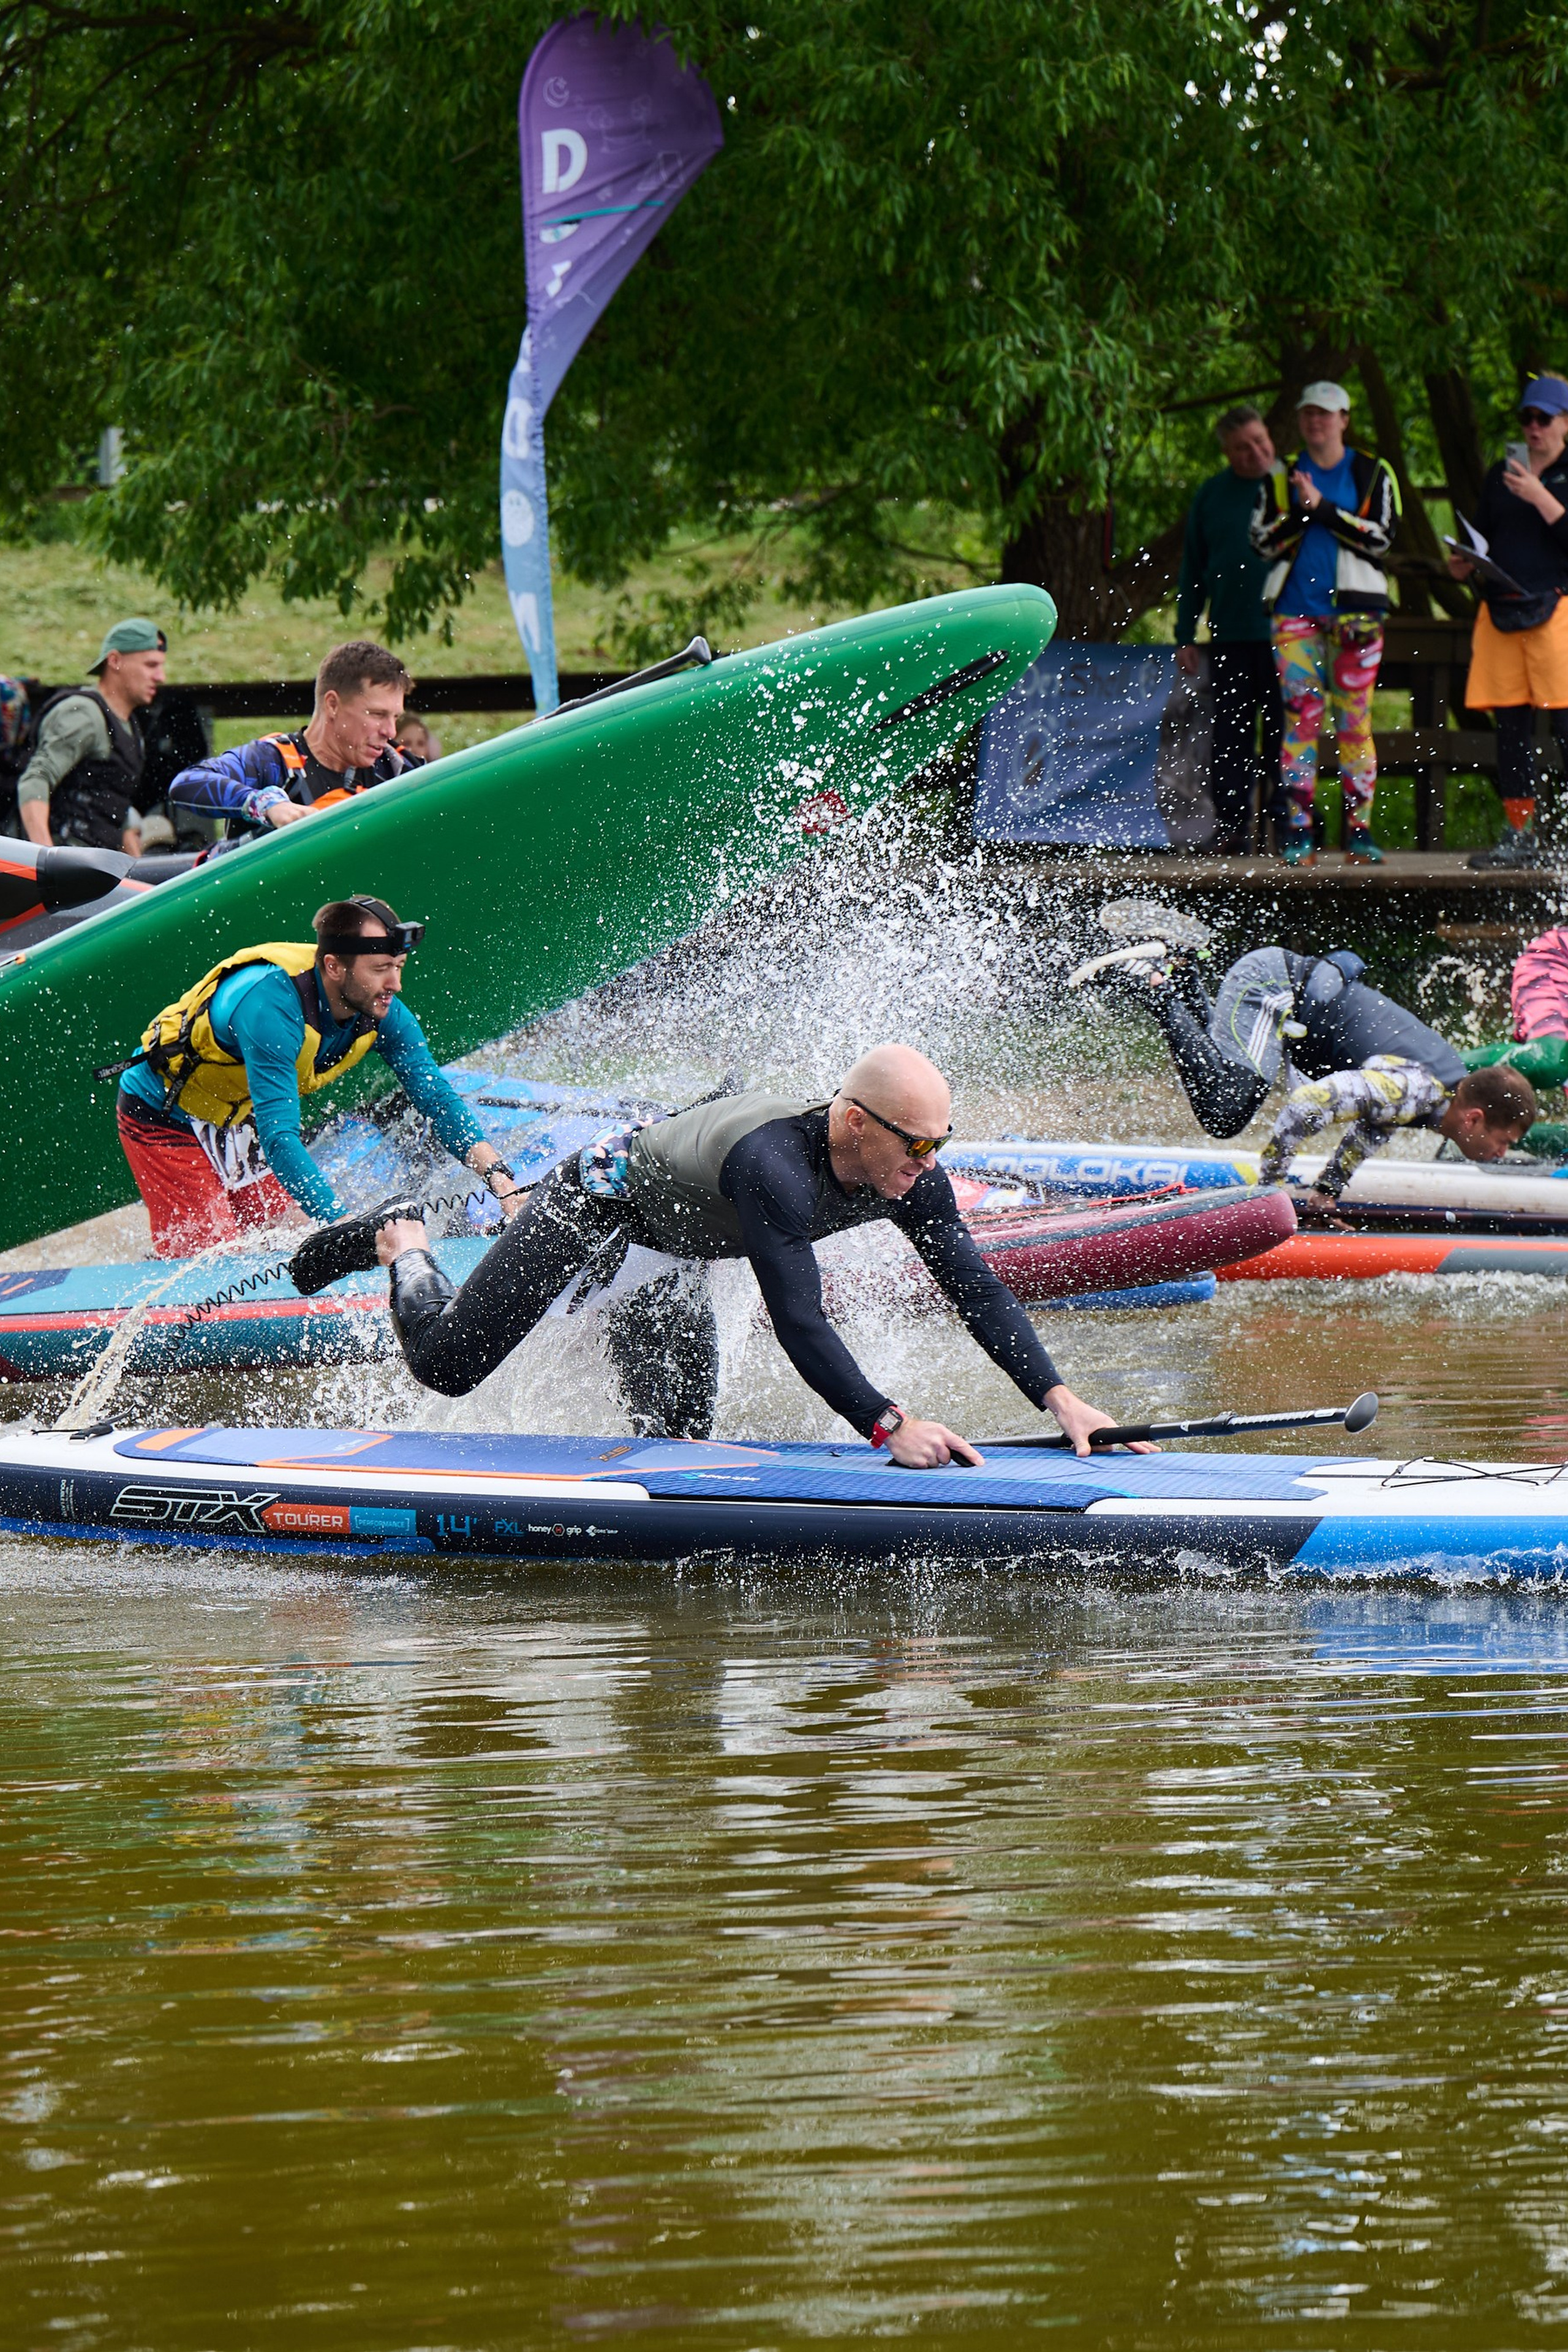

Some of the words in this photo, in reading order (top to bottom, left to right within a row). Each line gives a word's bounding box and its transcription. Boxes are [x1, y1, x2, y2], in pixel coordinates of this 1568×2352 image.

[987, 1156, 1189, 1183] MOLOKAI
[110, 1485, 282, 1533] STX
[273, 1512, 343, 1528] TOURER
[494, 1519, 524, 1534] FXL
[528, 1523, 552, 1534] honey
[566, 1525, 582, 1536] grip
